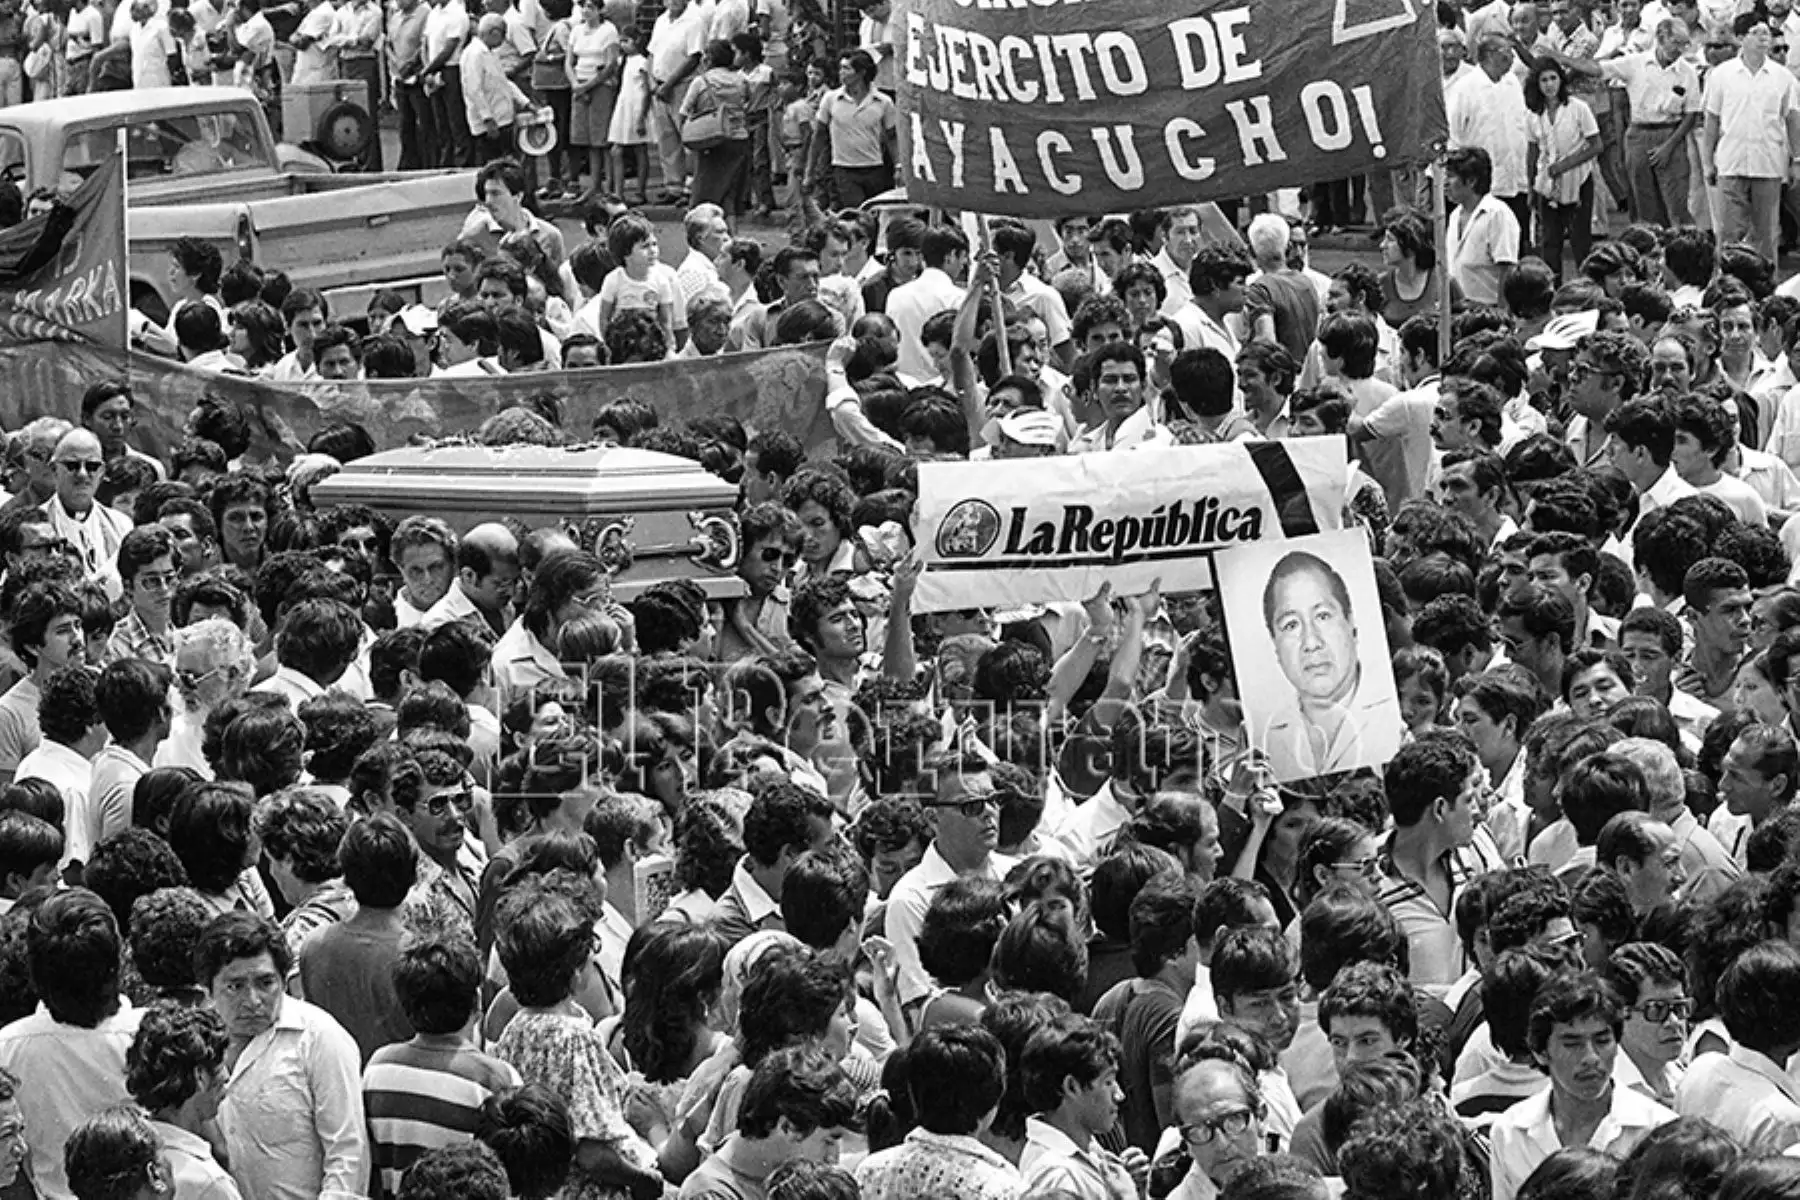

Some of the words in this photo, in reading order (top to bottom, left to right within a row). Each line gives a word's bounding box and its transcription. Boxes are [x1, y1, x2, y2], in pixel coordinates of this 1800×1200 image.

[906, 12, 1148, 103] EJERCITO
[1168, 6, 1263, 90] DE
[909, 80, 1387, 195] AYACUCHO!
